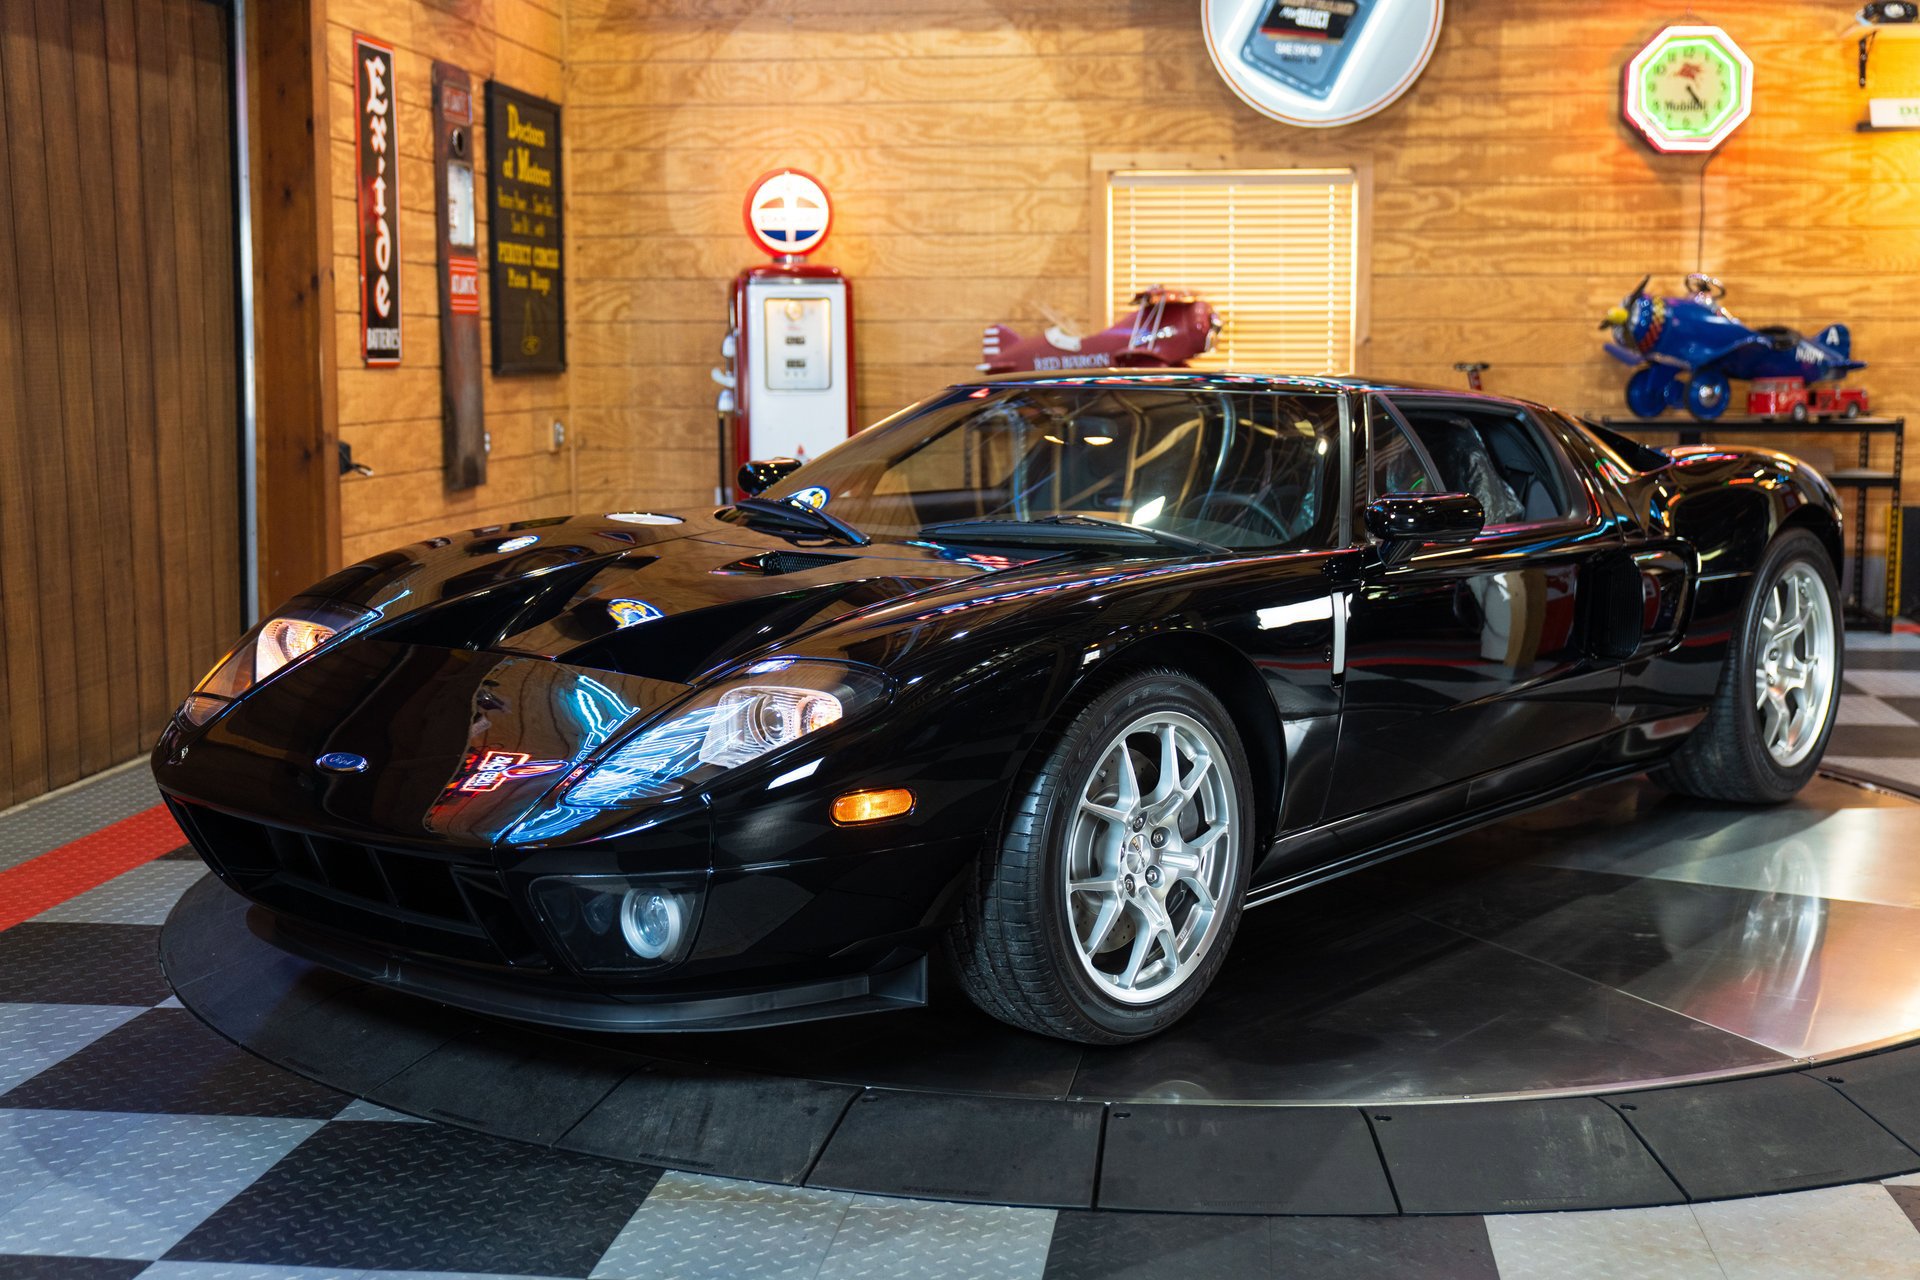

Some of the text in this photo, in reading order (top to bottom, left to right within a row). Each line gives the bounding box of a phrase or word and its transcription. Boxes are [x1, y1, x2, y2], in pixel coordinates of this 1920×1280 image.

[365, 55, 391, 318] Exide
[1826, 326, 1839, 346] A
[1034, 352, 1111, 372] RED BARON
[1795, 345, 1824, 367] NAVY
